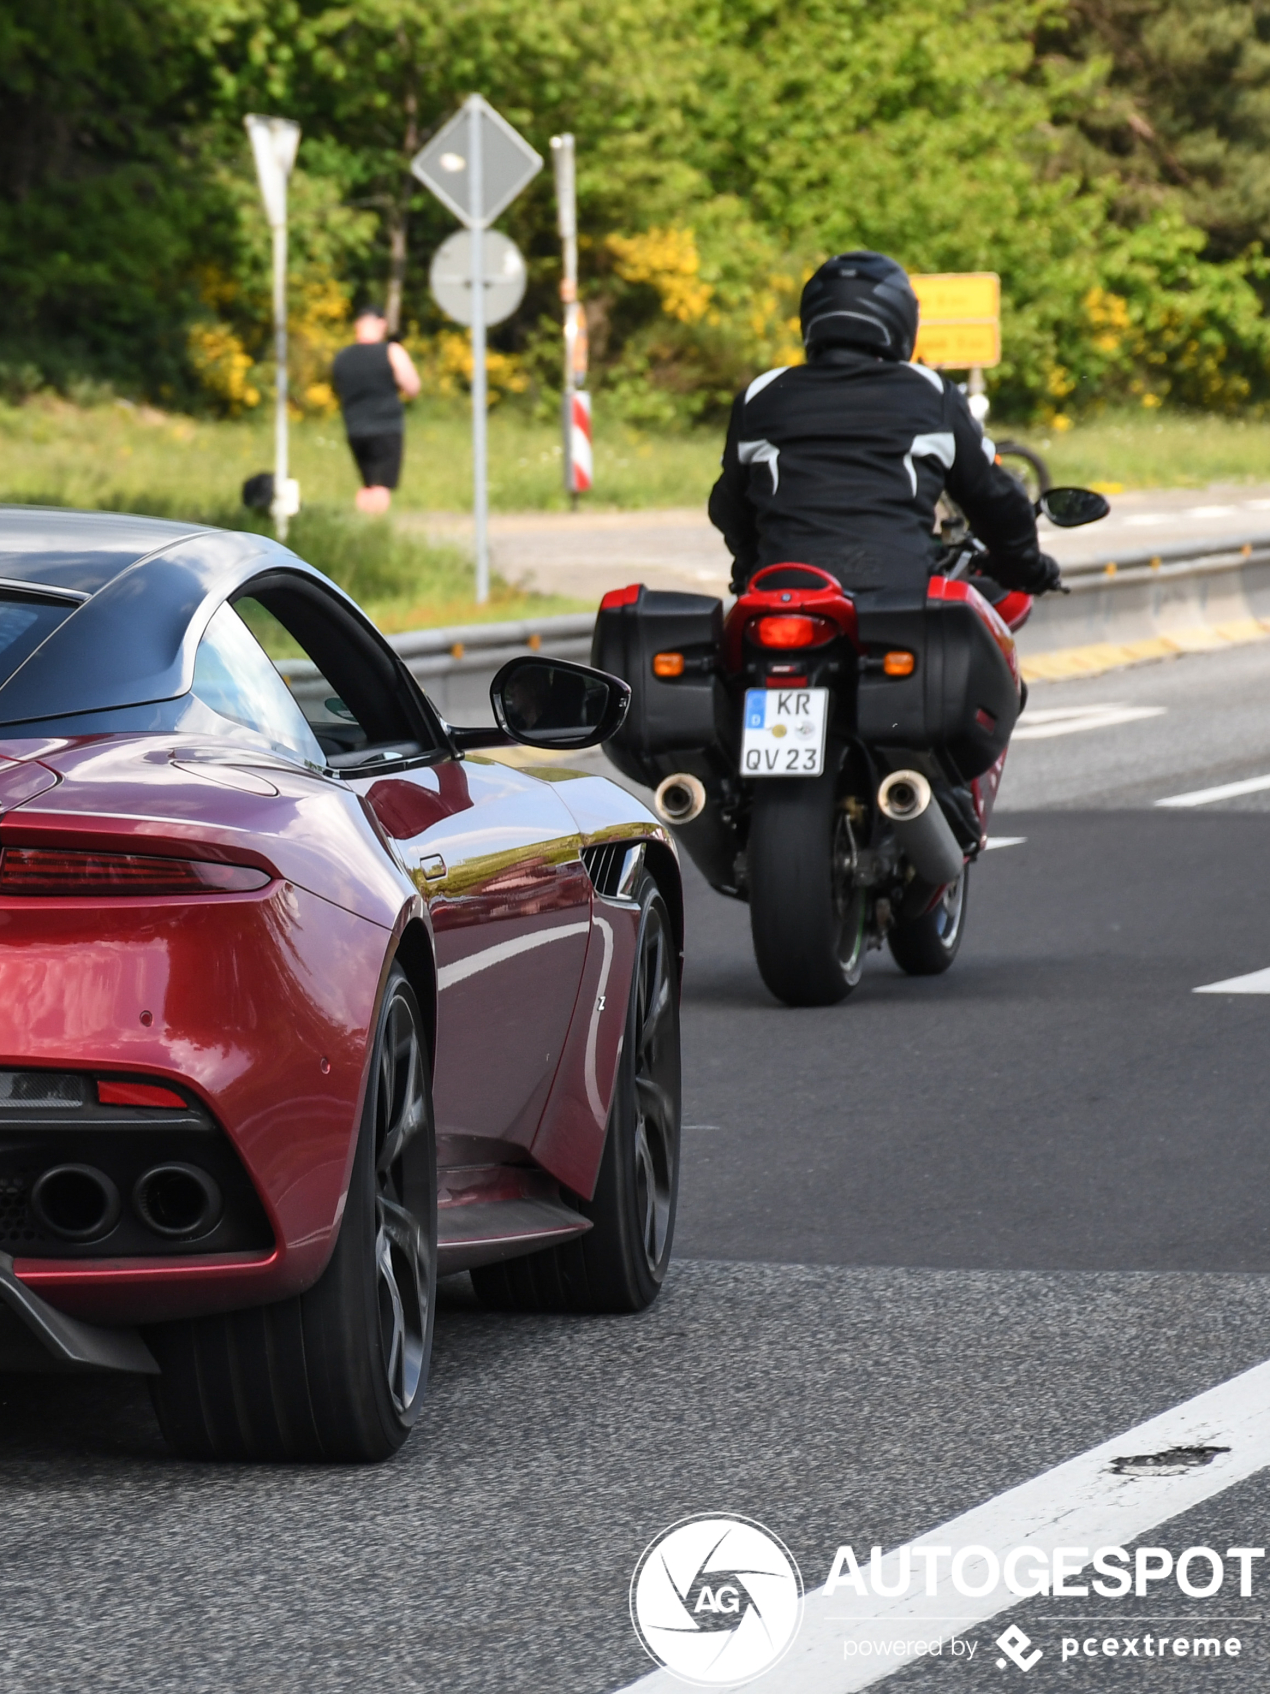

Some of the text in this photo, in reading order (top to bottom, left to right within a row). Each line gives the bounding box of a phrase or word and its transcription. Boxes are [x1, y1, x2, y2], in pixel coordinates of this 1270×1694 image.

[778, 693, 810, 715] KR
[752, 714, 761, 725] D
[746, 749, 817, 770] QV 23
